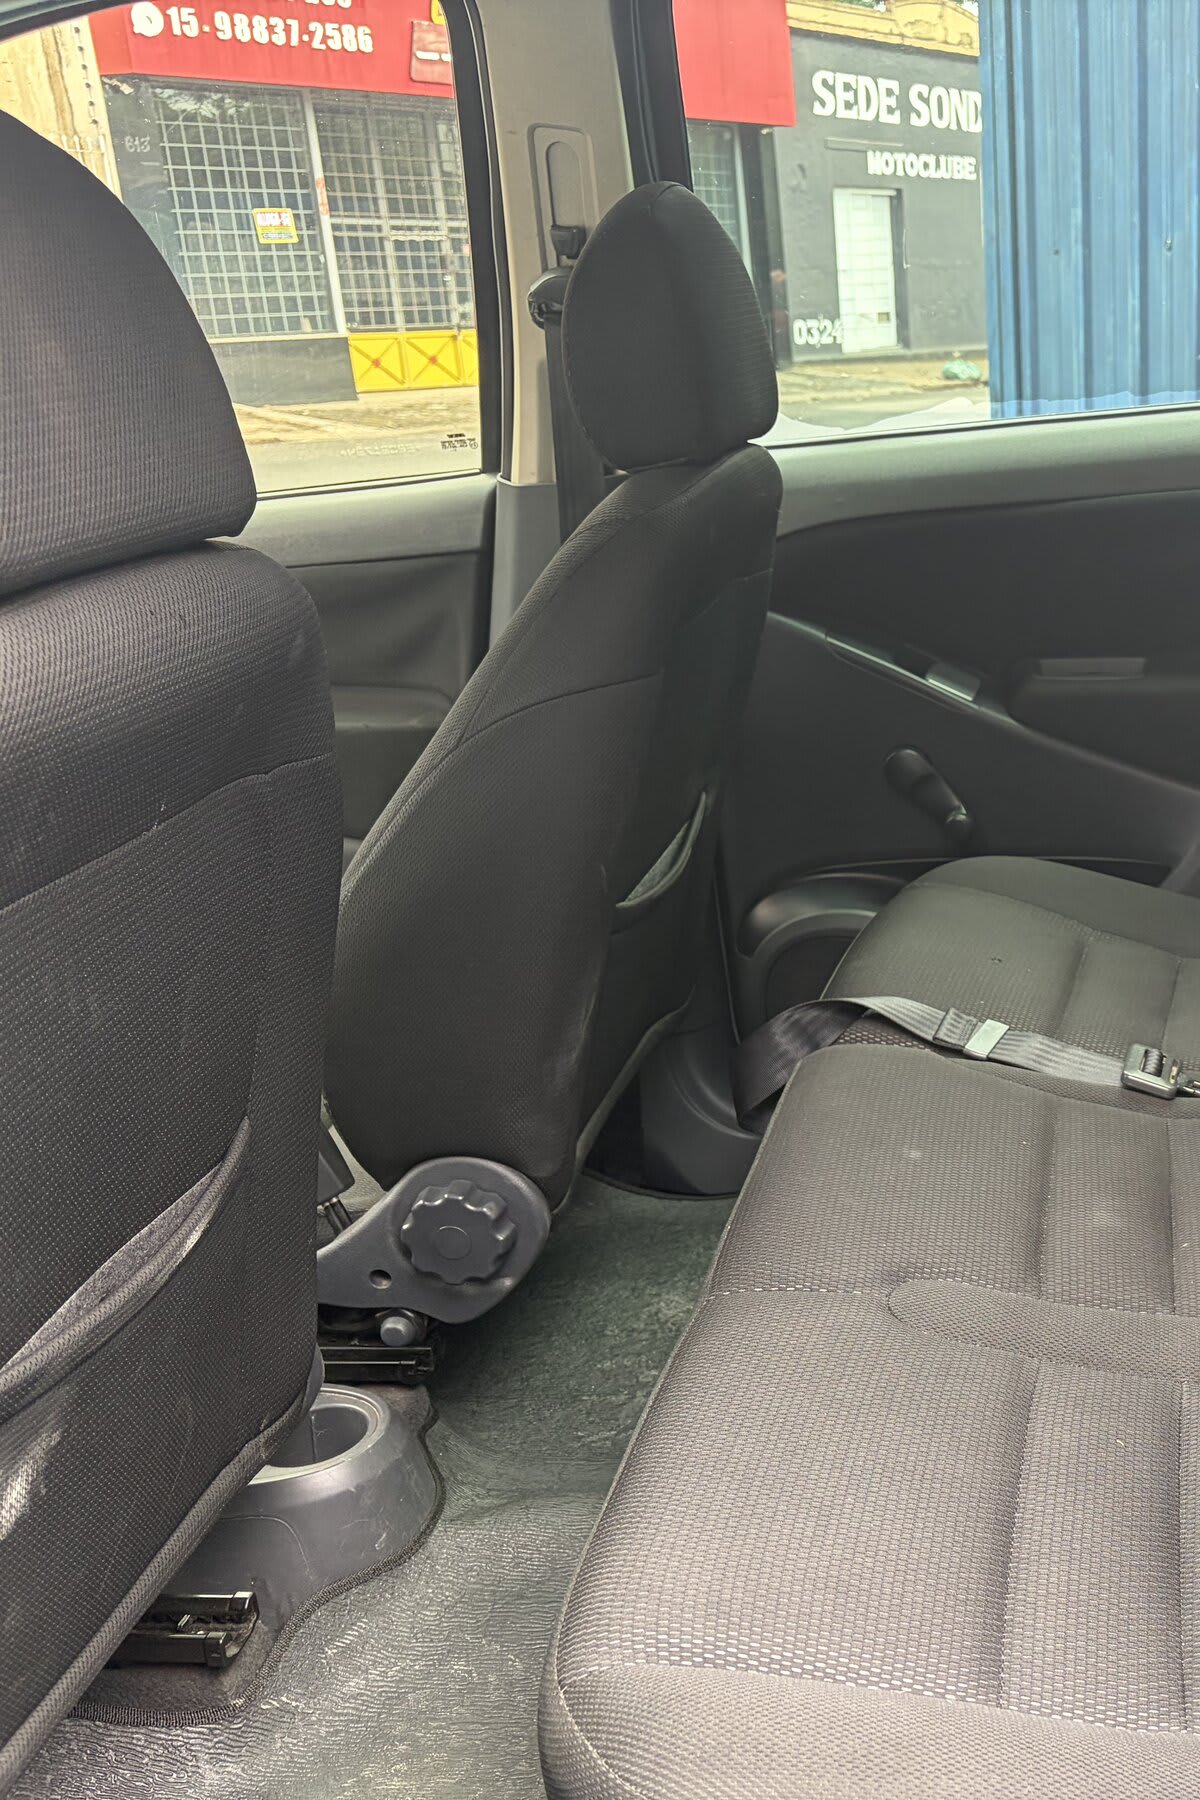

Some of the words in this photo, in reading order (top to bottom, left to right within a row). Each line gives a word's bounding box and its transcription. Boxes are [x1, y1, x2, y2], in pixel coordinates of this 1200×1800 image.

[811, 69, 901, 125] SEDE
[908, 83, 983, 133] SOND
[866, 150, 977, 181] MOTOCLUBE
